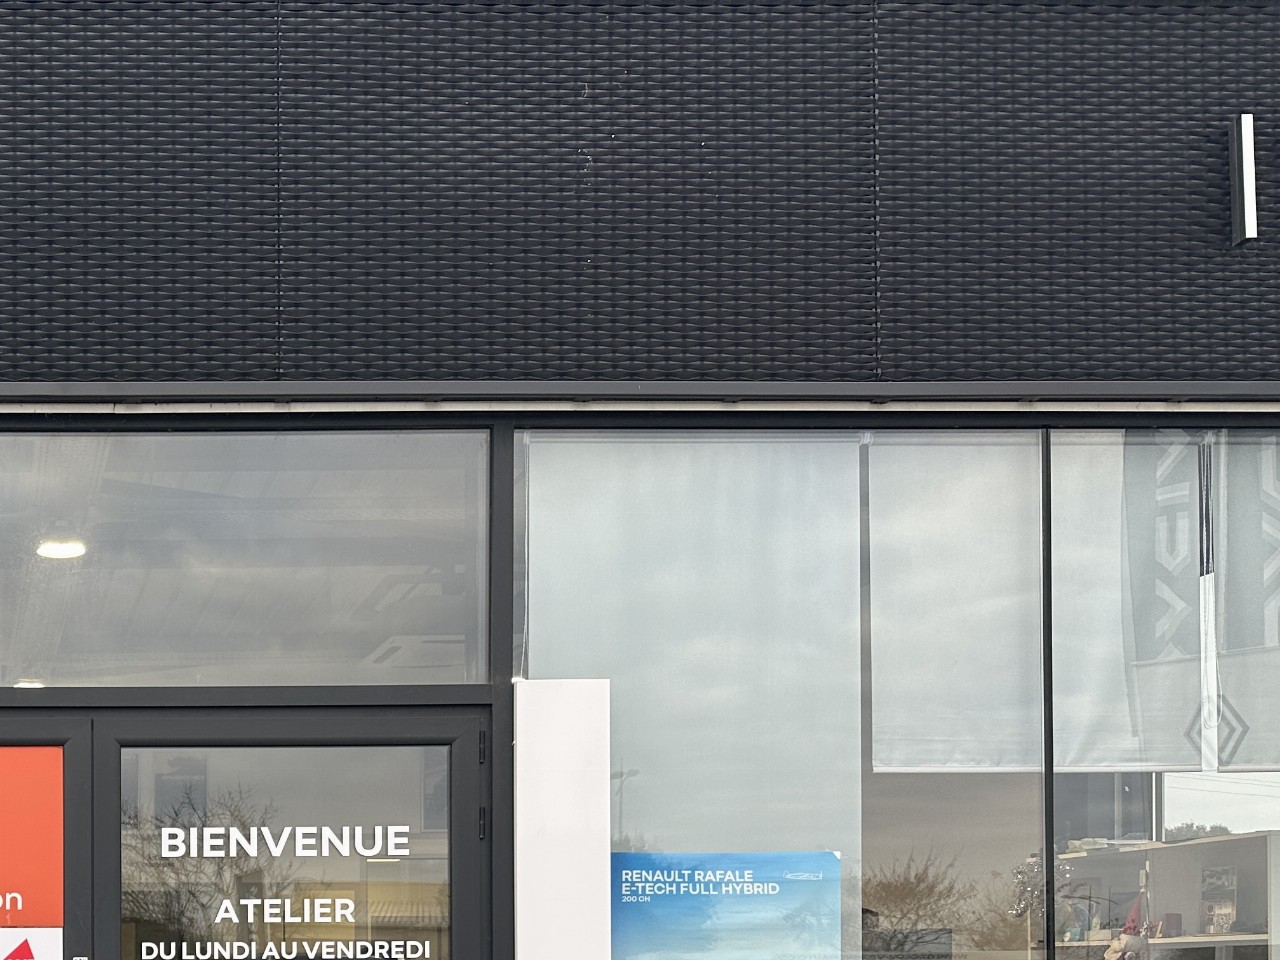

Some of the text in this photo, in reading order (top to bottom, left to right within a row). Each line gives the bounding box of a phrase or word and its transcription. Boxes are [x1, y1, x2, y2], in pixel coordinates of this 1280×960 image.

[161, 826, 410, 858] BIENVENUE
[621, 869, 753, 882] RENAULT RAFALE
[621, 883, 780, 895] E-TECH FULL HYBRID
[214, 898, 356, 923] ATELIER
[141, 940, 430, 960] DU LUNDI AU VENDREDI
